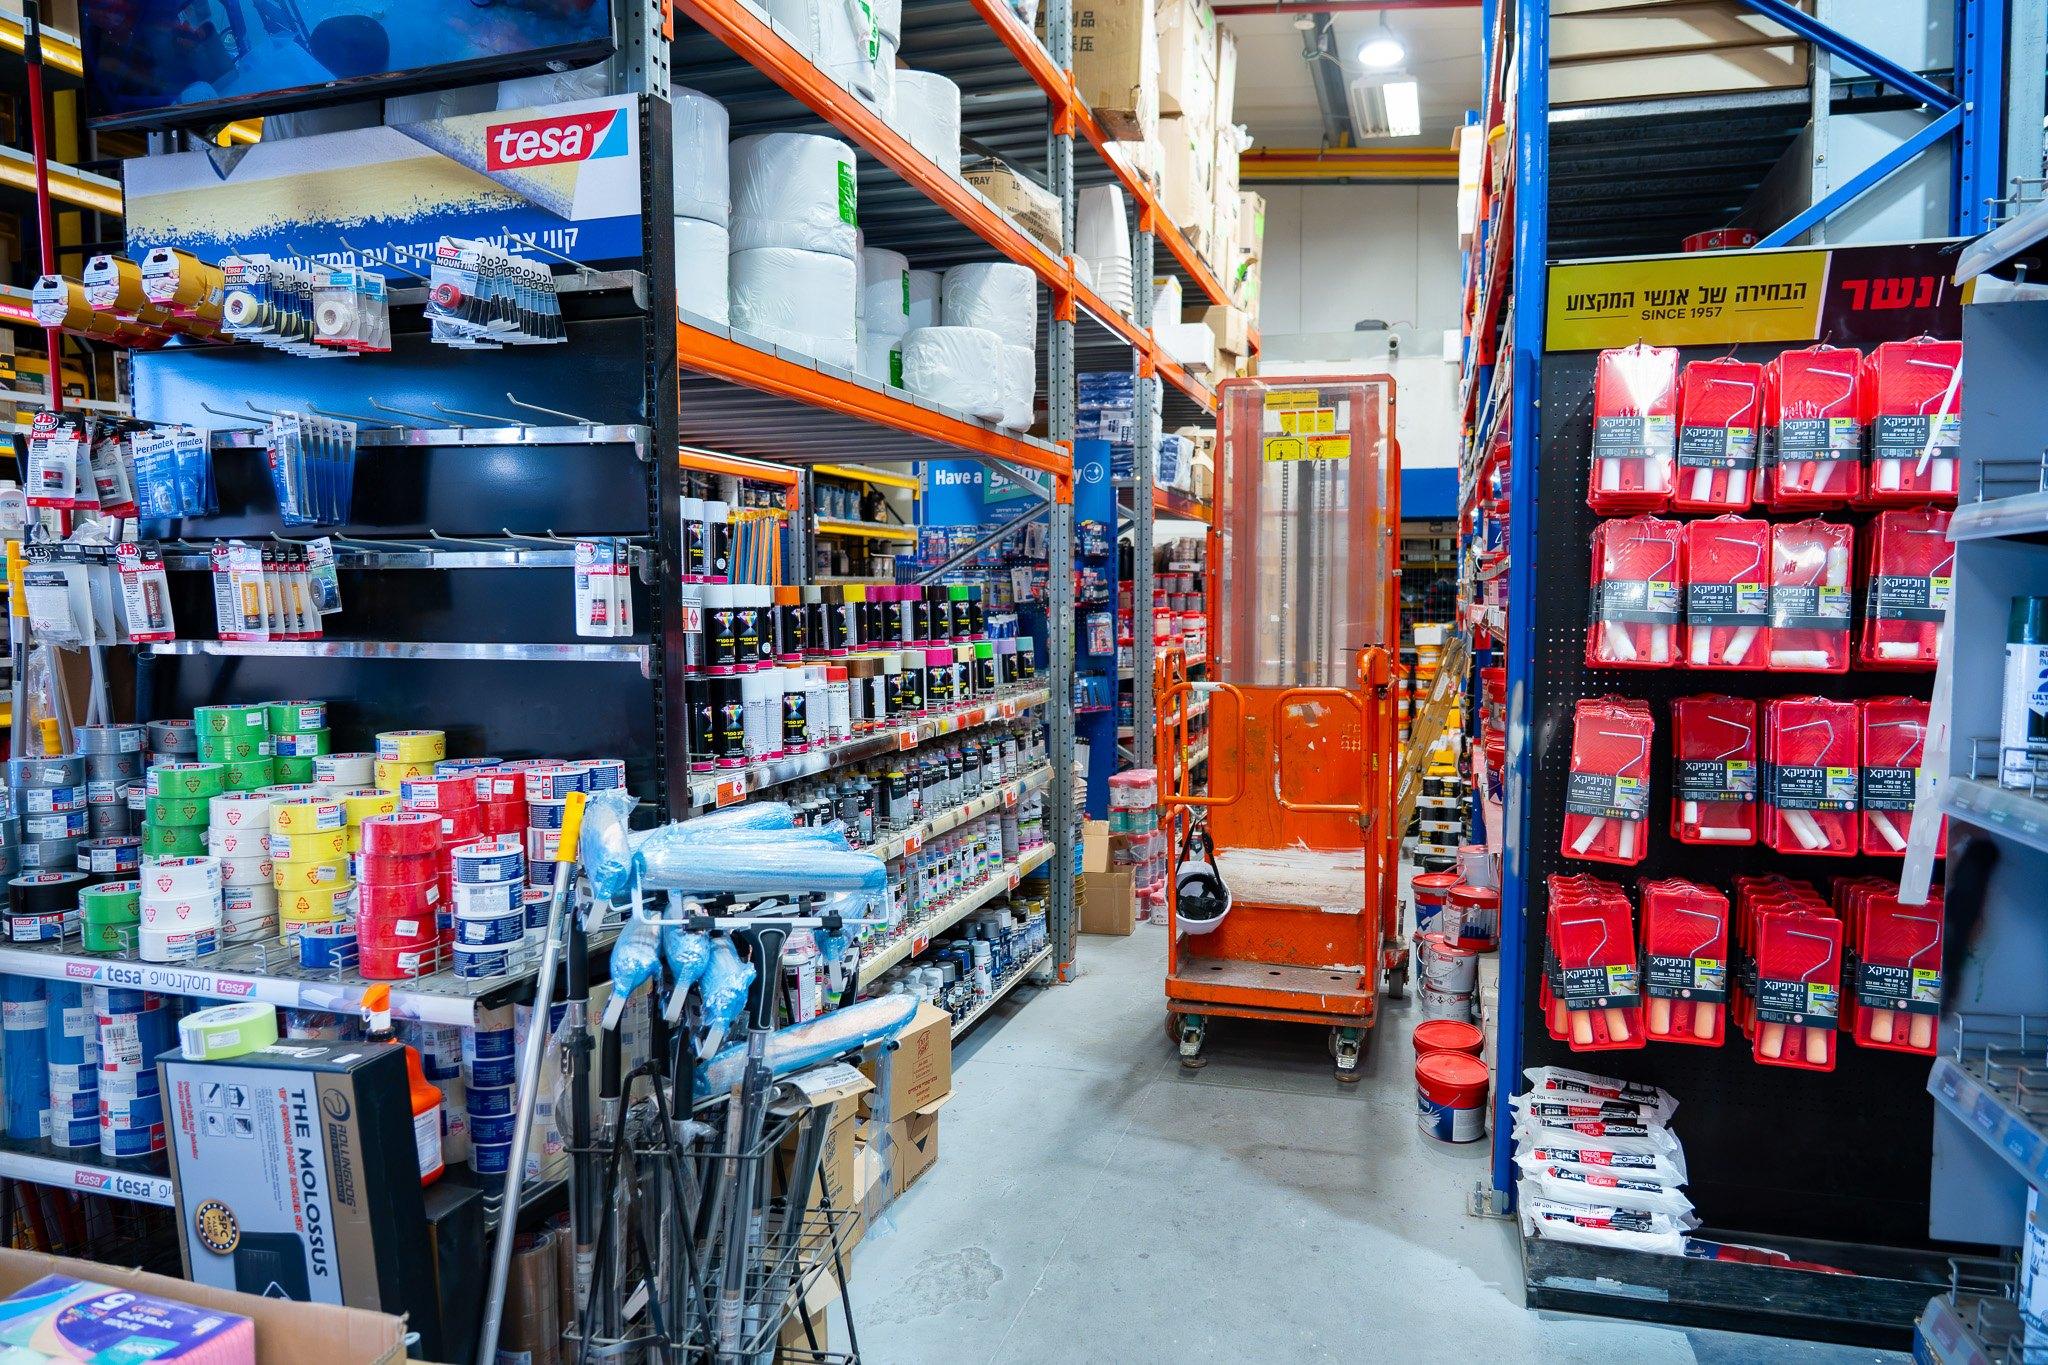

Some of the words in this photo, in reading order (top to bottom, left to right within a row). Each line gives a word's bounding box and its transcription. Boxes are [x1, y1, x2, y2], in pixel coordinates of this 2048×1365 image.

[494, 124, 584, 163] tesa
[968, 176, 991, 186] TRAY
[543, 228, 579, 254] קווי
[362, 246, 388, 268] עם
[436, 257, 479, 272] MOUNTING
[1566, 291, 1634, 313] המקצוע
[1644, 288, 1689, 307] אנשי
[1698, 285, 1727, 305] של
[1735, 282, 1807, 303] הבחירה
[1841, 276, 1935, 311] נשר
[1641, 308, 1686, 321] SINCE
[1691, 306, 1723, 318] 1957
[177, 438, 203, 449] rmatex
[935, 469, 975, 486] Have
[975, 472, 983, 484] a
[41, 874, 61, 882] tesa
[14, 918, 32, 926] tesa
[68, 964, 92, 978] tesa
[106, 965, 143, 985] tesa
[150, 970, 211, 993] מסקנטייפ
[218, 979, 246, 994] tesa
[291, 1088, 311, 1139] THE
[77, 1172, 101, 1186] tesa
[116, 1176, 150, 1198] tesa
[298, 1148, 328, 1278] MOLOSSUS
[205, 1216, 213, 1235] PACK
[211, 1216, 219, 1238] VALUE
